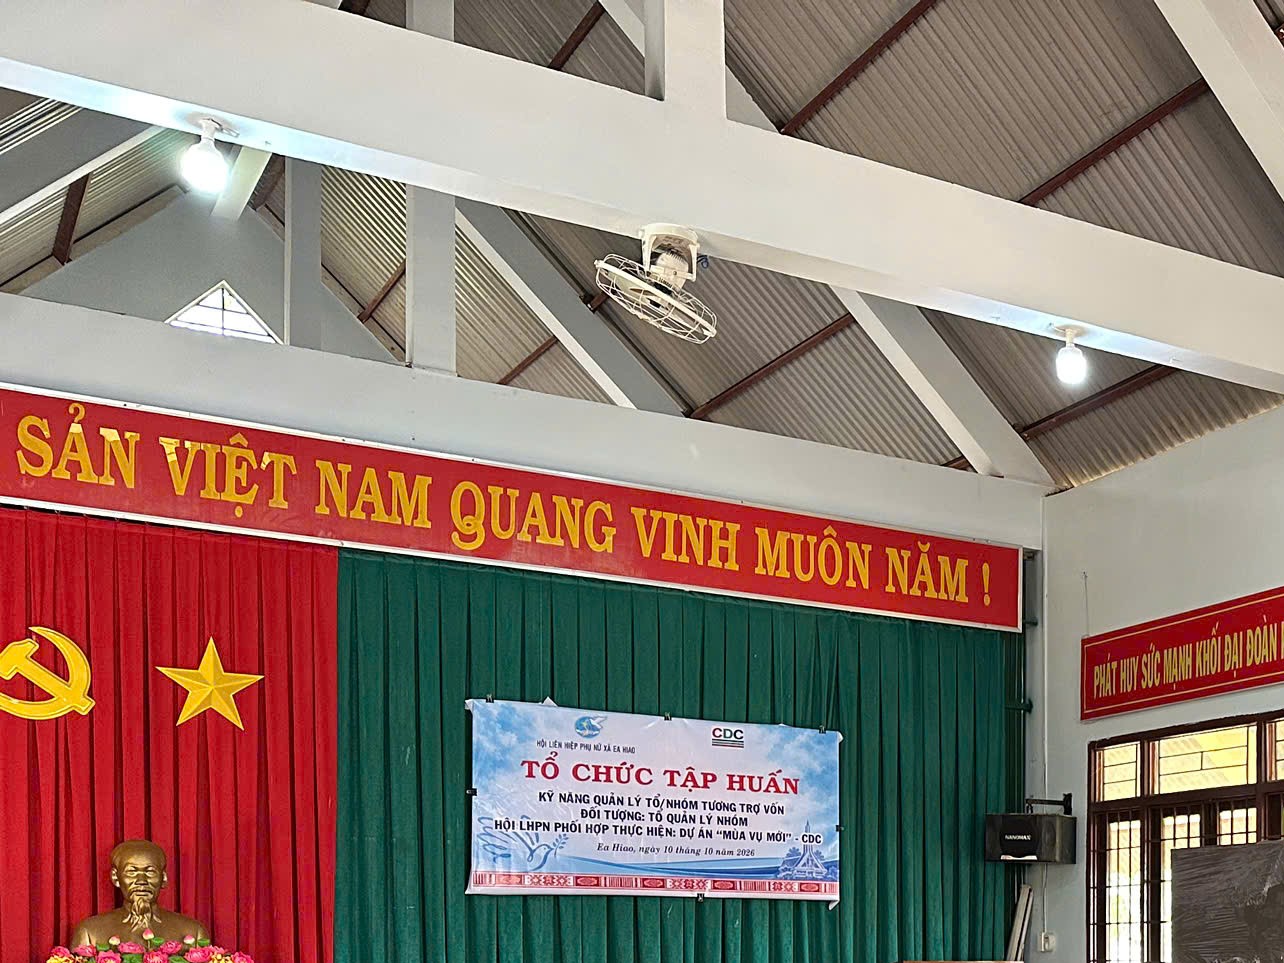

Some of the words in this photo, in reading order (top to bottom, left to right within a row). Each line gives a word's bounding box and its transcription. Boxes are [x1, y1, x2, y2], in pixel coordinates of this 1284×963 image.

[16, 403, 140, 489] SẢN
[159, 432, 297, 518] VIỆT
[315, 459, 432, 529] NAM
[451, 481, 616, 553] QUANG
[631, 506, 741, 571] VINH
[754, 525, 872, 589] MUÔN
[885, 541, 969, 603] NĂM
[982, 562, 991, 606] !
[1093, 653, 1118, 699] PHÁT
[1120, 656, 1140, 693] HUY
[1141, 643, 1161, 689] SỨC
[1163, 644, 1192, 690] MẠNH
[1195, 621, 1221, 678] KHỐI
[1224, 634, 1243, 678] ĐẠI
[1246, 615, 1278, 667] ĐOÀN
[712, 728, 744, 740] CDC
[520, 751, 560, 780] TỔ
[571, 761, 654, 785] CHỨC
[663, 766, 717, 792] TẬP
[726, 769, 799, 795] HUẤN
[538, 790, 554, 802] KỸ
[559, 791, 590, 804] NĂNG
[593, 792, 624, 807] QUẢN
[628, 793, 642, 807] LÝ
[645, 793, 698, 811] TỔ/NHÓM
[701, 800, 737, 812] TƯƠNG
[740, 803, 761, 815] TRỢ
[764, 801, 785, 815] VỐN
[580, 806, 600, 820] ĐỐI
[604, 809, 645, 822] TƯỢNG:
[649, 808, 663, 822] TỔ
[667, 811, 696, 825] QUẢN
[699, 812, 713, 825] LÝ
[717, 814, 748, 827] NHÓM
[494, 817, 515, 831] HỘI
[519, 821, 550, 832] LHPN
[554, 819, 582, 833] PHỐI
[585, 822, 609, 835] HỢP
[612, 823, 643, 836] THỰC
[647, 826, 676, 838] HIỆN:
[679, 827, 696, 839] DỰ
[697, 826, 713, 839] ÁN
[749, 831, 762, 842] VỤ
[802, 834, 822, 844] CDC
[597, 843, 611, 851] Ea
[612, 843, 636, 853] Hiao,
[638, 844, 660, 855] ngày
[676, 845, 701, 856] tháng
[704, 846, 713, 855] 10
[715, 847, 734, 856] năm
[736, 848, 755, 857] 2026
